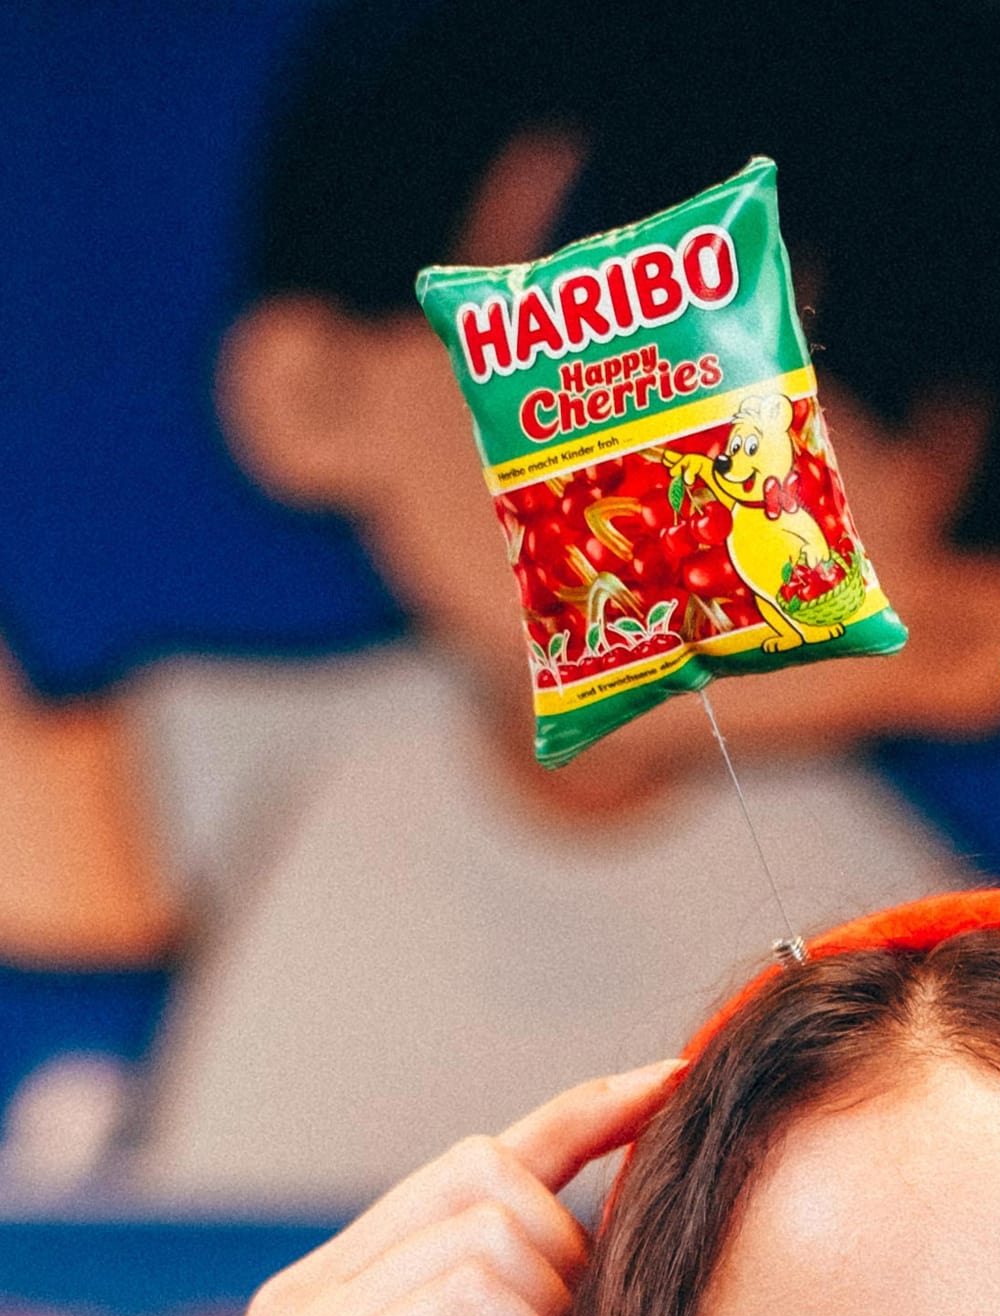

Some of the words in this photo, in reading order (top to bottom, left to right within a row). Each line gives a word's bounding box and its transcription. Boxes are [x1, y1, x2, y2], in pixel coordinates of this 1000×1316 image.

[459, 229, 735, 380] HARIBO
[520, 355, 722, 441] Cherries
[561, 345, 657, 393] Happy
[528, 456, 559, 473] macht
[560, 443, 595, 461] Kinder
[597, 436, 620, 450] froh
